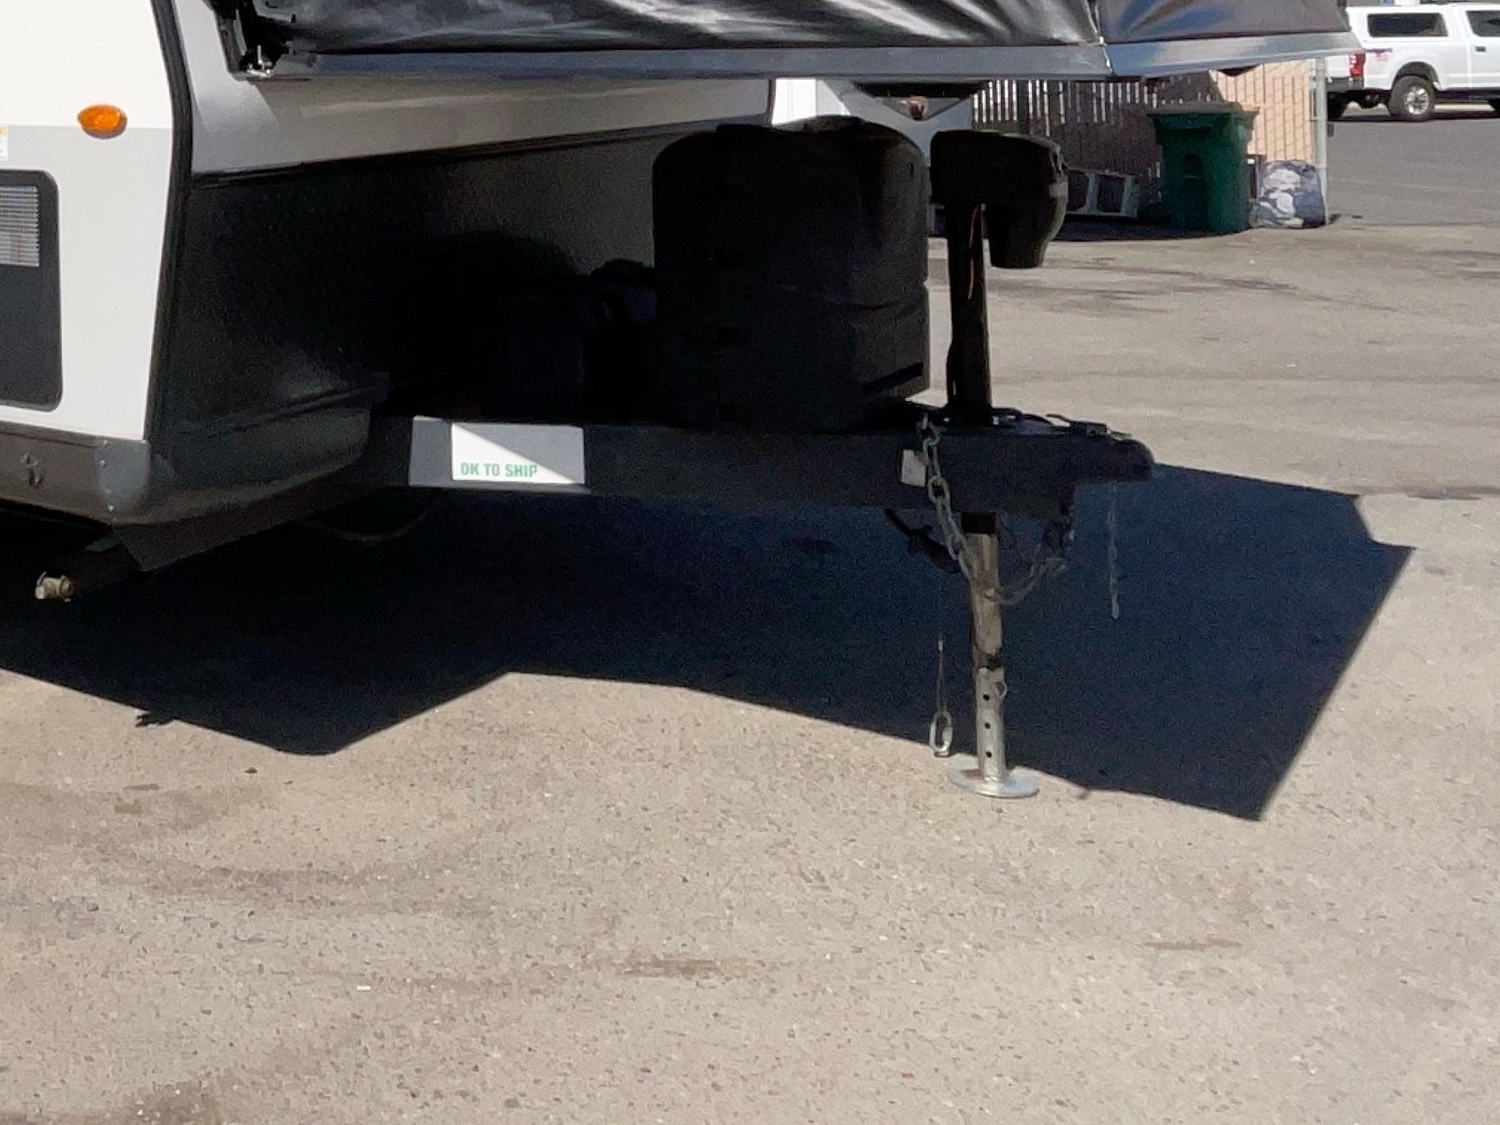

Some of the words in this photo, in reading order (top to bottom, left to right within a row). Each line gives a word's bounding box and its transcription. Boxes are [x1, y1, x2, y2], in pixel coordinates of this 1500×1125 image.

[460, 462, 479, 476] OK
[483, 463, 500, 477] TO
[505, 463, 538, 478] SHIP
